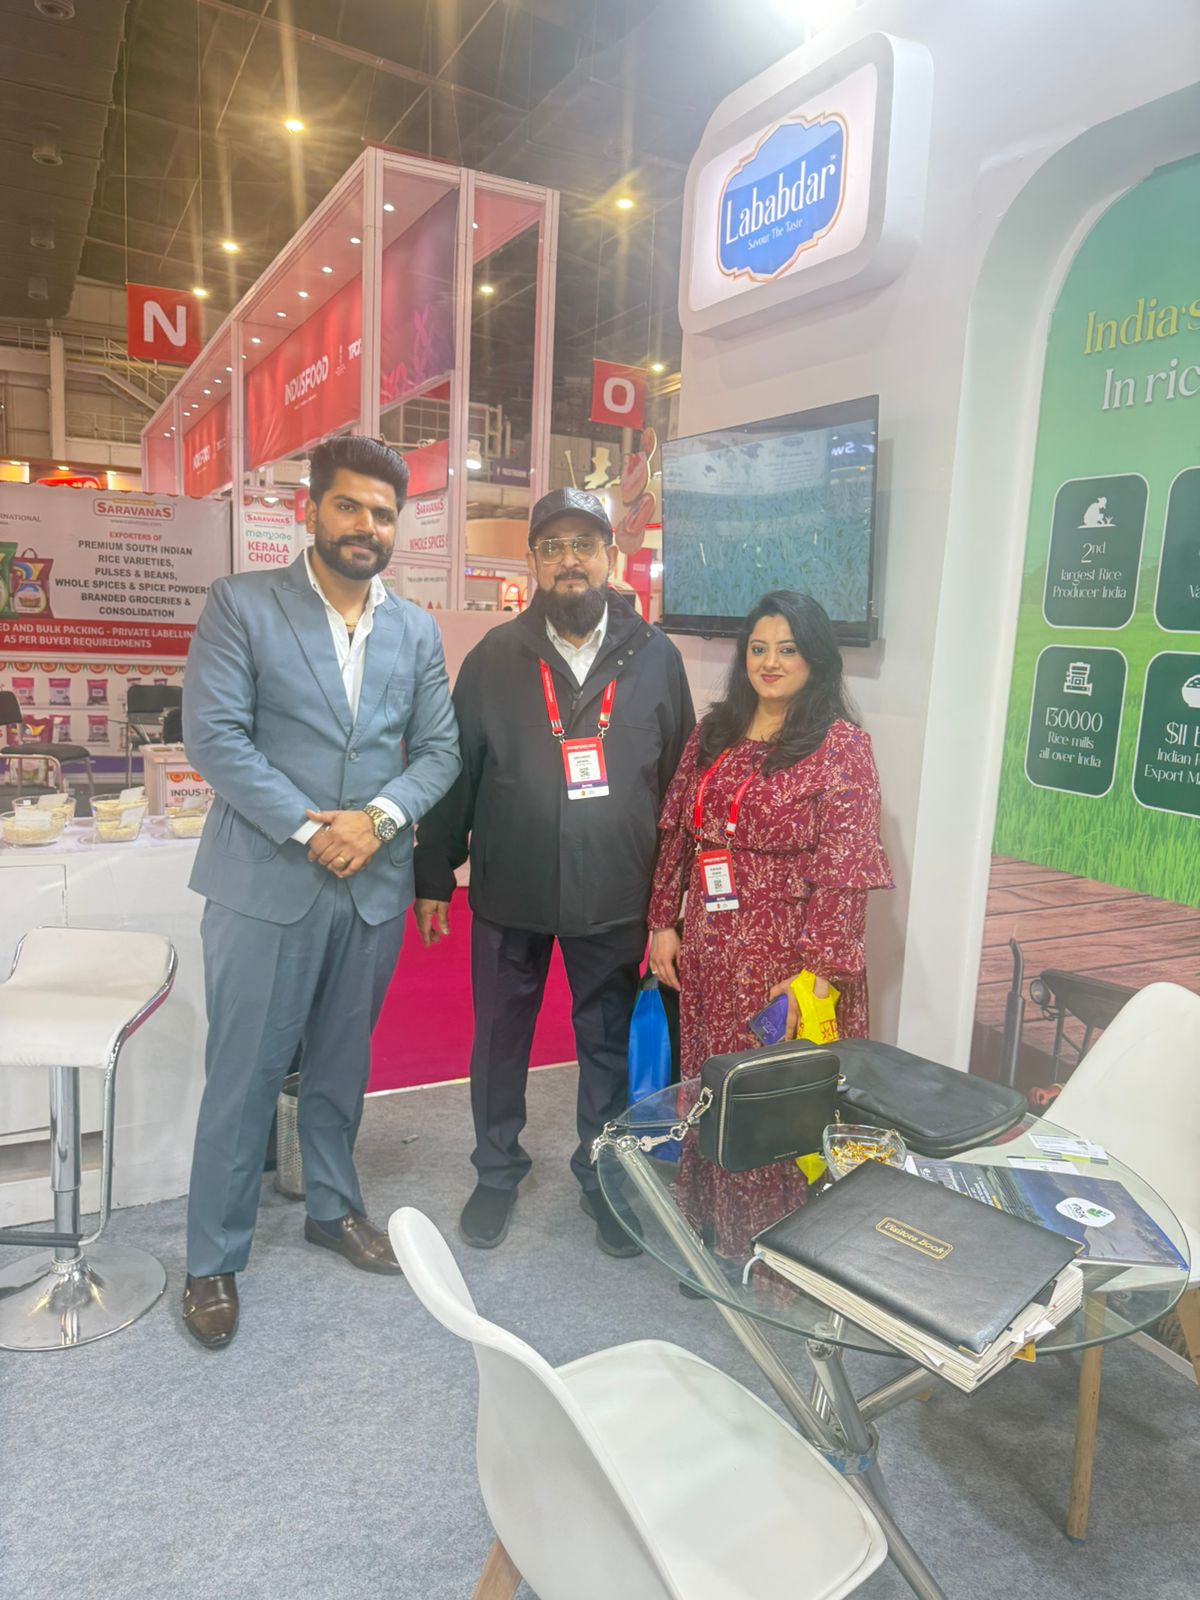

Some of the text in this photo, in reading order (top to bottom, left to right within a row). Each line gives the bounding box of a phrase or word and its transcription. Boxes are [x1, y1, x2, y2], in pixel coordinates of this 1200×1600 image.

[725, 160, 836, 245] Lababdar
[143, 300, 187, 347] N
[603, 377, 635, 414] O
[1102, 367, 1136, 410] In
[97, 502, 172, 518] SARAVANAS
[109, 531, 152, 541] EXPORTERS
[78, 540, 192, 556] PREMIUM SOUTH INDIAN
[248, 541, 289, 553] KERALA
[1081, 541, 1106, 563] 2nd
[98, 554, 174, 568] RICE VARIETIES,
[248, 552, 289, 564] CHOICE
[95, 567, 178, 581] PULSES & BEANS,
[1060, 567, 1122, 586] largest Rice
[55, 578, 90, 588] WHOLE
[92, 580, 127, 590] SPICES
[129, 582, 136, 590] &
[138, 583, 166, 592] SPICE
[1052, 585, 1127, 599] Producer India
[81, 592, 191, 606] BRANDED GROCERIES &
[99, 606, 175, 618] CONSOLIDATION
[12, 623, 34, 633] AND
[36, 624, 62, 634] BULK
[63, 625, 104, 636] PACKING
[112, 627, 151, 638] PRIVATE
[3, 634, 152, 648] AS PER BUYER REQUIREDMENTS
[1048, 730, 1095, 750] Rice mills
[1039, 747, 1102, 768] all over India
[1157, 747, 1191, 765] Indian
[1144, 764, 1183, 783] Export
